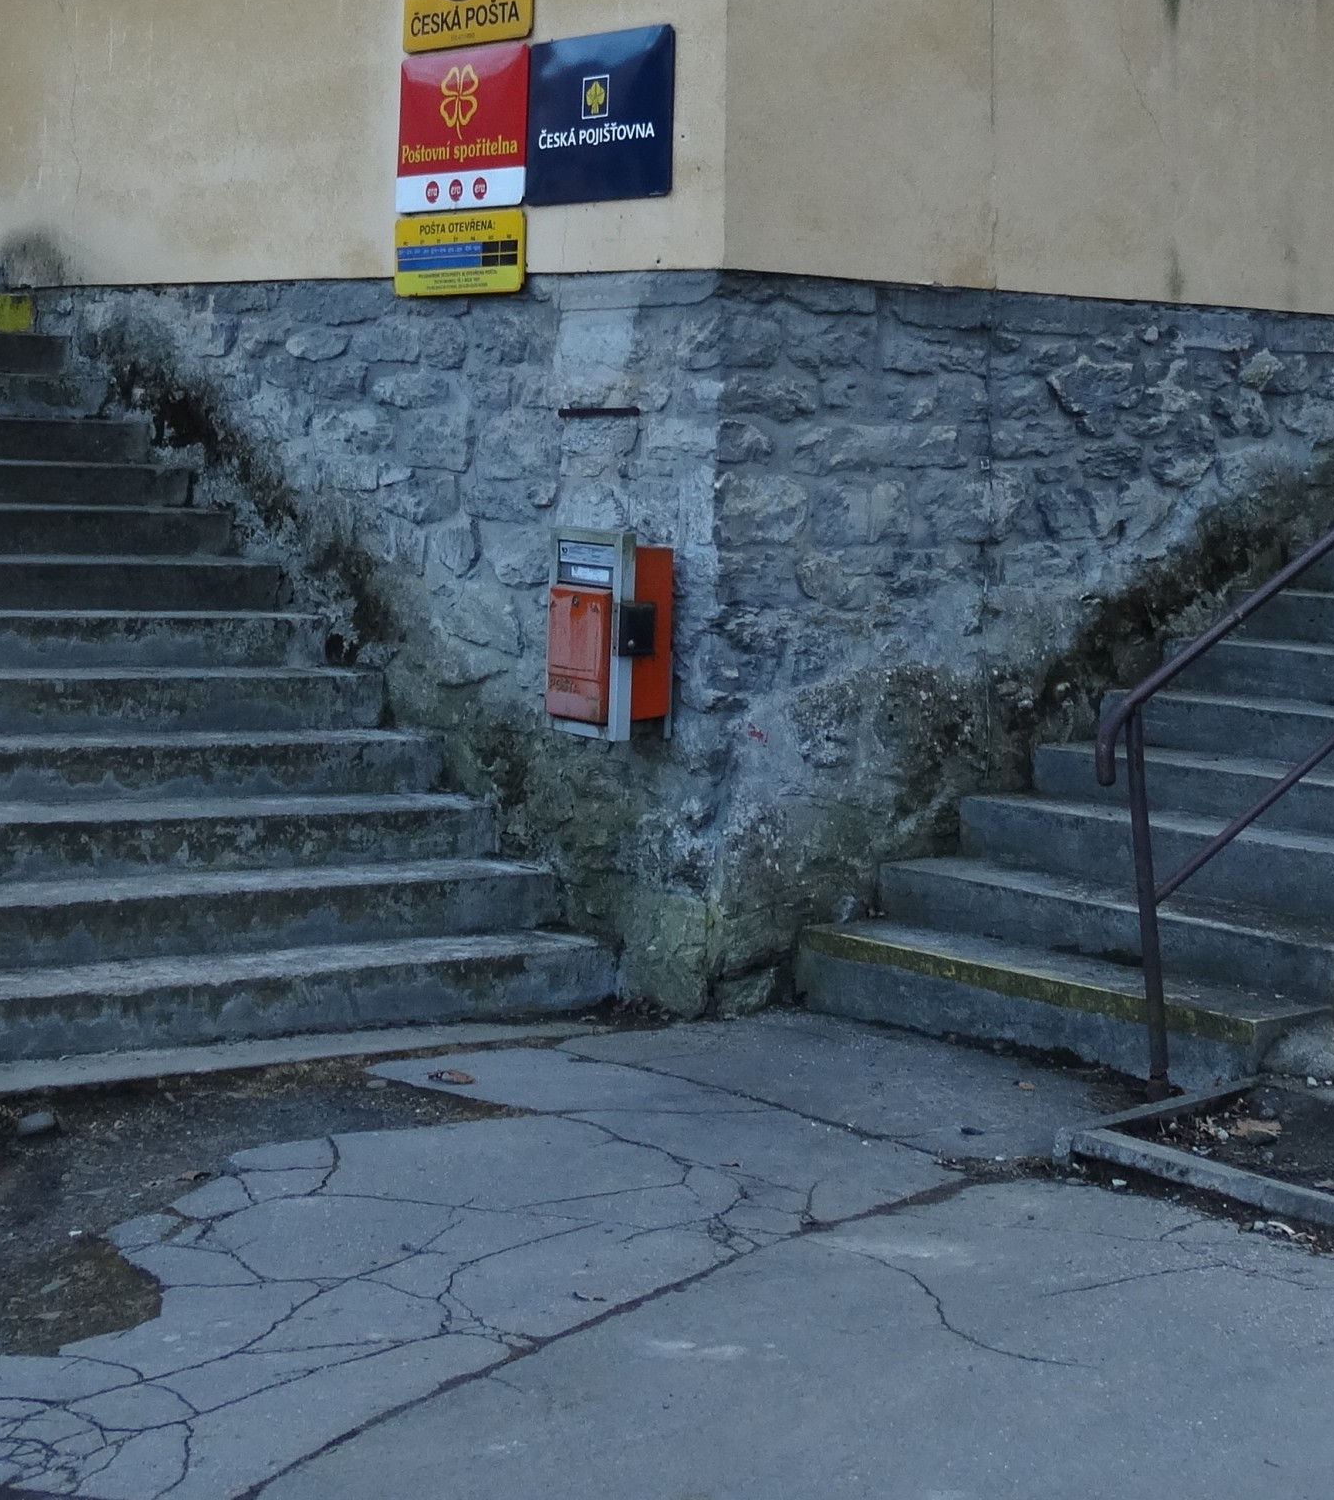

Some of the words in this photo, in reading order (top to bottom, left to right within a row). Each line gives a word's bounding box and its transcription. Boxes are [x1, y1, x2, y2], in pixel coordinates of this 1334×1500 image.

[410, 5, 462, 38] ČESKÁ
[465, 0, 520, 30] POŠTA
[538, 127, 577, 150] ČESKÁ
[579, 121, 656, 146] POJIŠŤOVNA
[401, 141, 450, 165] Poštovní
[453, 134, 518, 163] spořitelna
[427, 187, 438, 198] era
[450, 185, 462, 196] era
[474, 183, 486, 194] era
[419, 221, 446, 236] POŠTA
[448, 218, 496, 234] OTEVŘENA:
